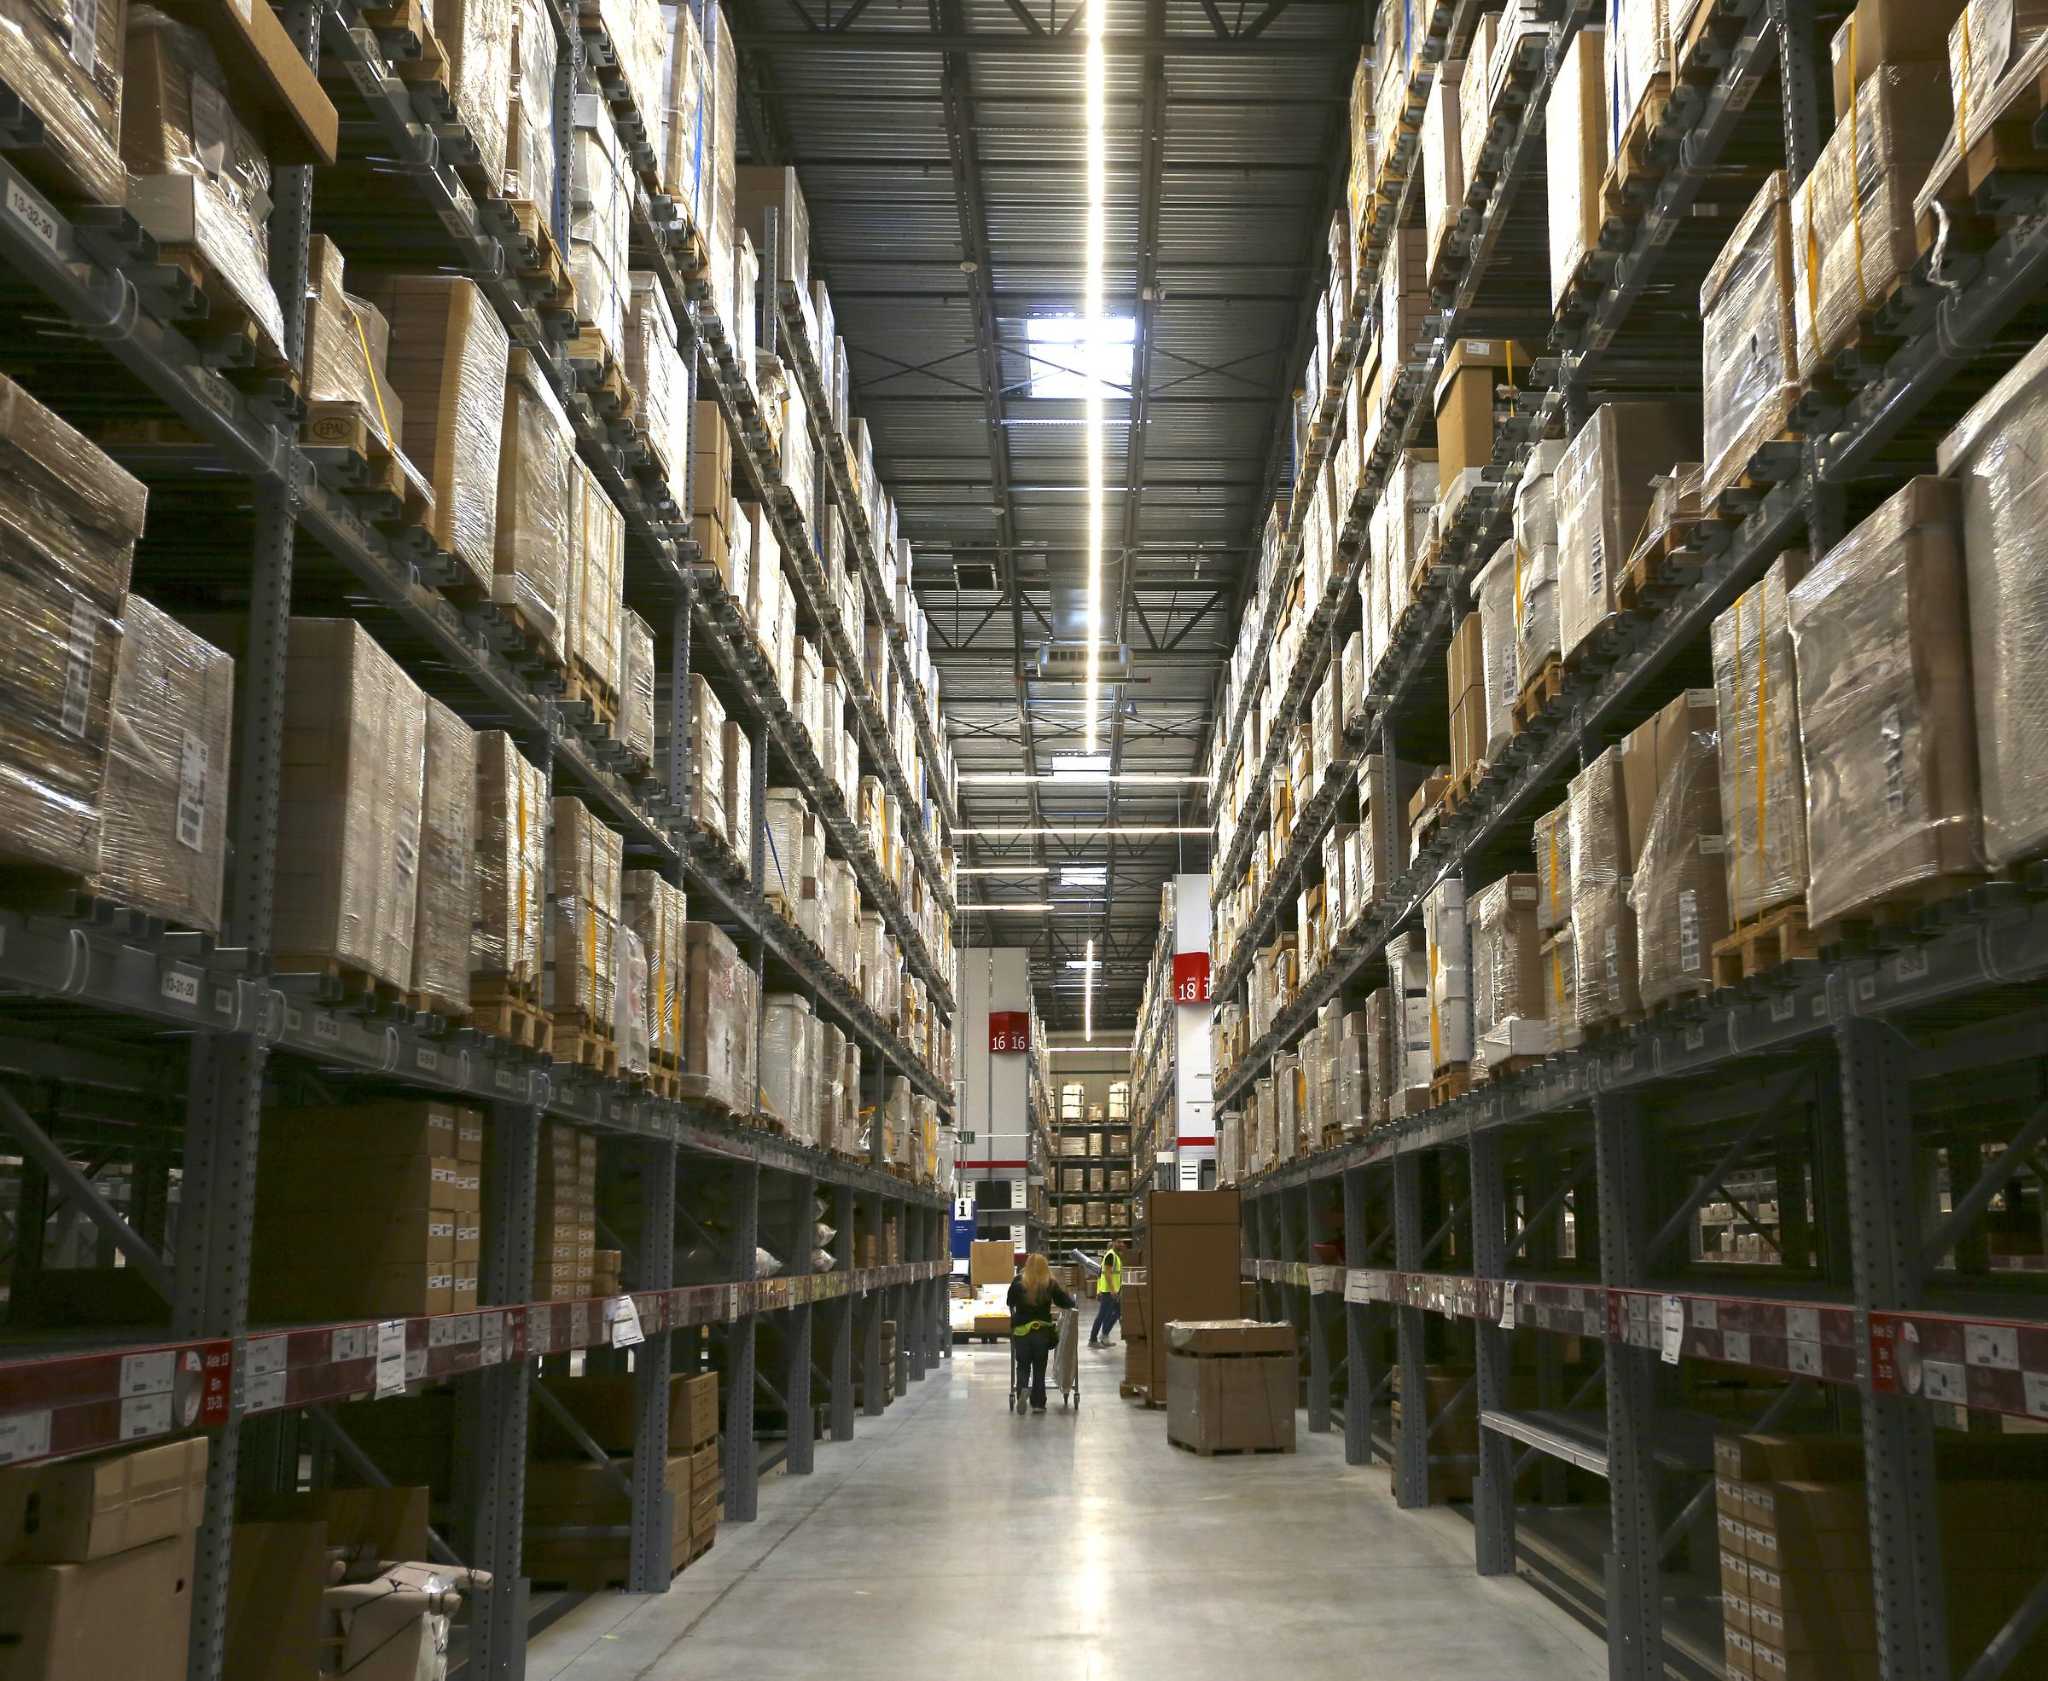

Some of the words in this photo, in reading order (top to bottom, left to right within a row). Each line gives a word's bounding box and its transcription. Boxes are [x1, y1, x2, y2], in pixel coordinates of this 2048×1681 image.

[1178, 982, 1197, 1001] 18
[1203, 982, 1210, 1000] 1
[991, 1035, 1006, 1050] 16
[1011, 1035, 1026, 1050] 16
